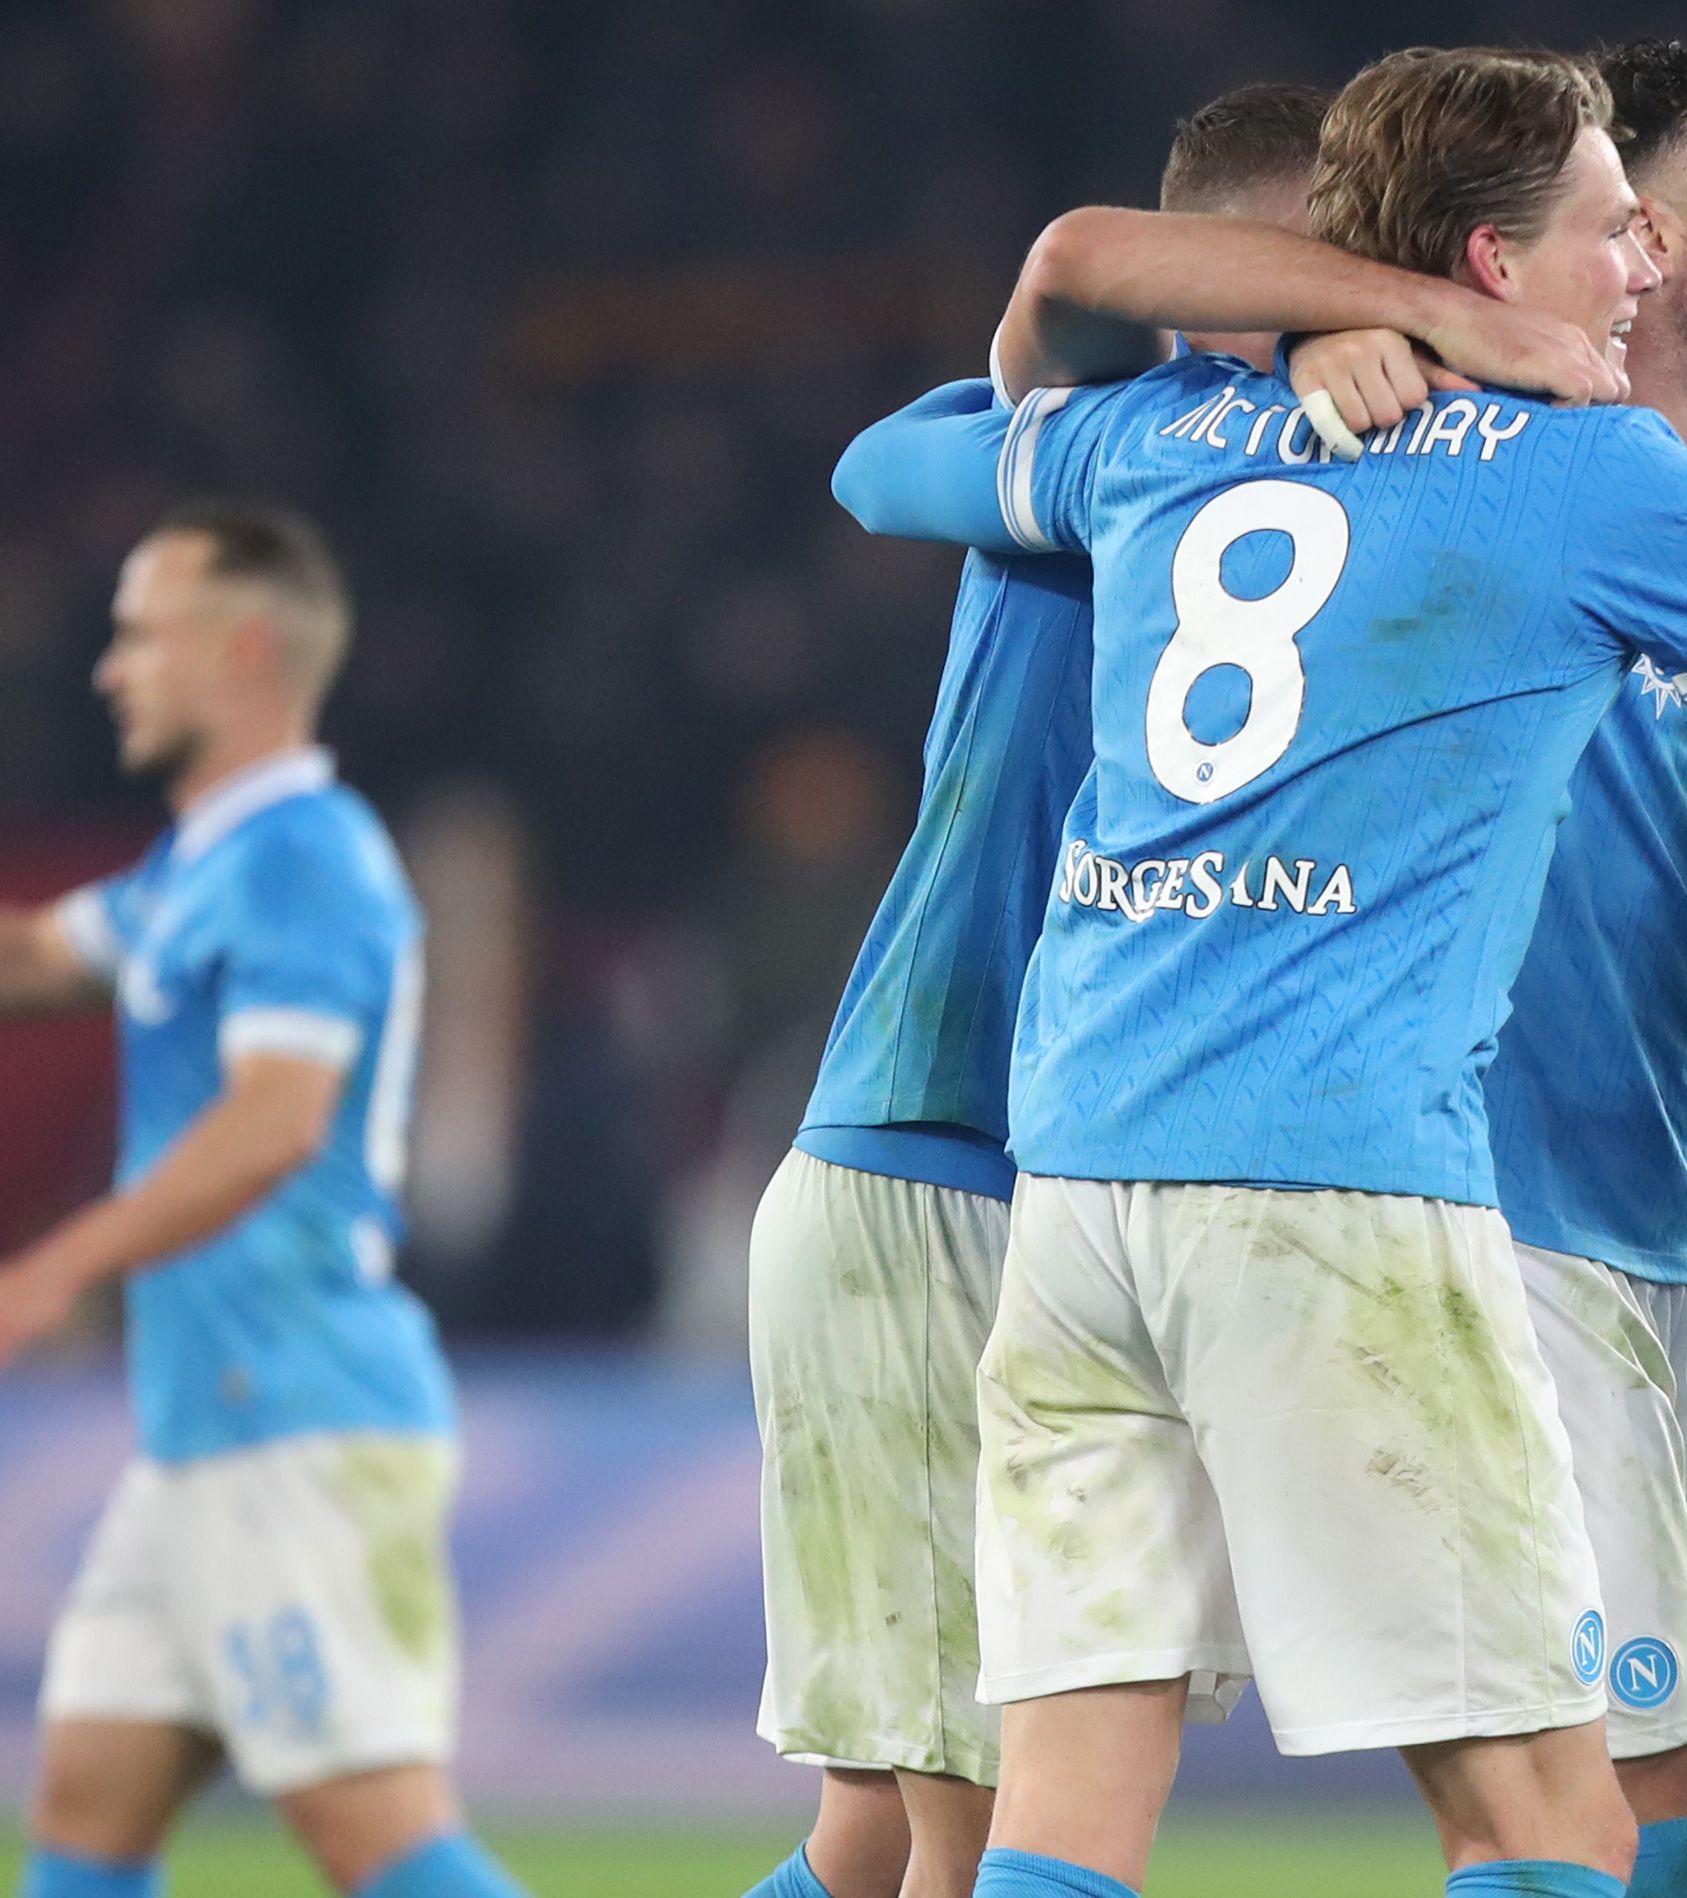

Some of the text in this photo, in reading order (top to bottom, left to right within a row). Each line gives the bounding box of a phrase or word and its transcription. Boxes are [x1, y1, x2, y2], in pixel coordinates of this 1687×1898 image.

[1159, 385, 1531, 465] MCTONAY
[1145, 478, 1350, 804] 8
[1578, 1626, 1597, 1667] N
[1626, 1654, 1659, 1692] N
